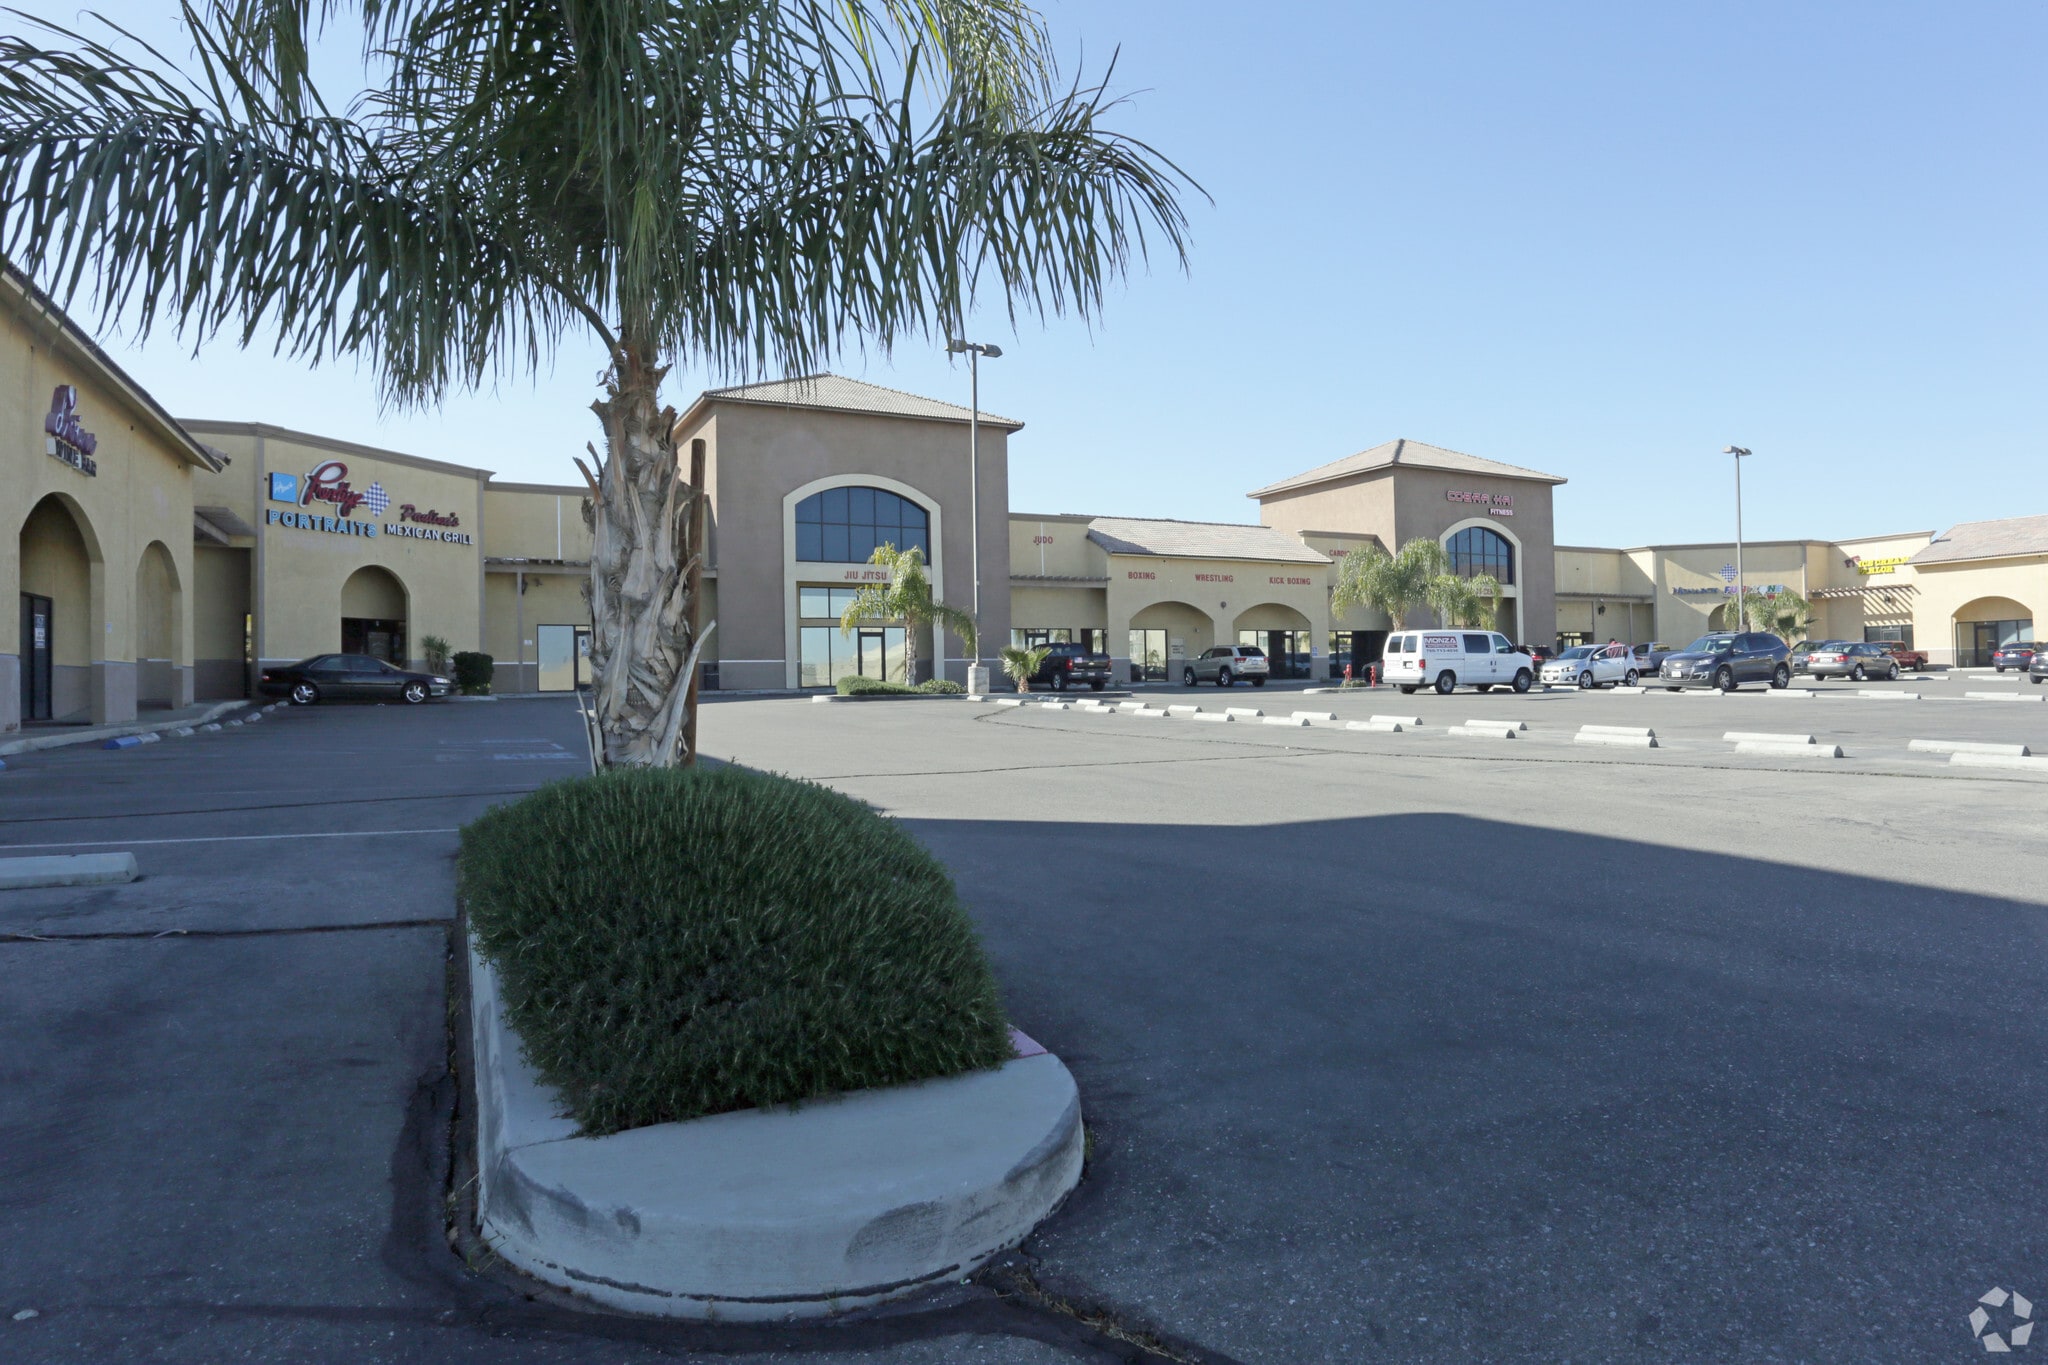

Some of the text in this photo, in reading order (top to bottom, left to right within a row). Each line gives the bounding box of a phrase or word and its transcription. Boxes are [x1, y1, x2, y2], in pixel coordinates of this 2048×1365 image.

[299, 460, 368, 518] Prestige
[1447, 490, 1513, 506] COBRA KAI
[1488, 508, 1513, 516] FITNESS
[266, 508, 378, 538] PORTRAITS
[384, 523, 474, 546] MEXICAN GRILL
[1033, 536, 1054, 546] JUDO
[1329, 549, 1350, 557] CARDI
[844, 570, 887, 581] JIU JITSU
[1128, 571, 1156, 580] BOXING
[1195, 574, 1234, 583] WRESTLING
[1269, 577, 1311, 585] KICK BOXING
